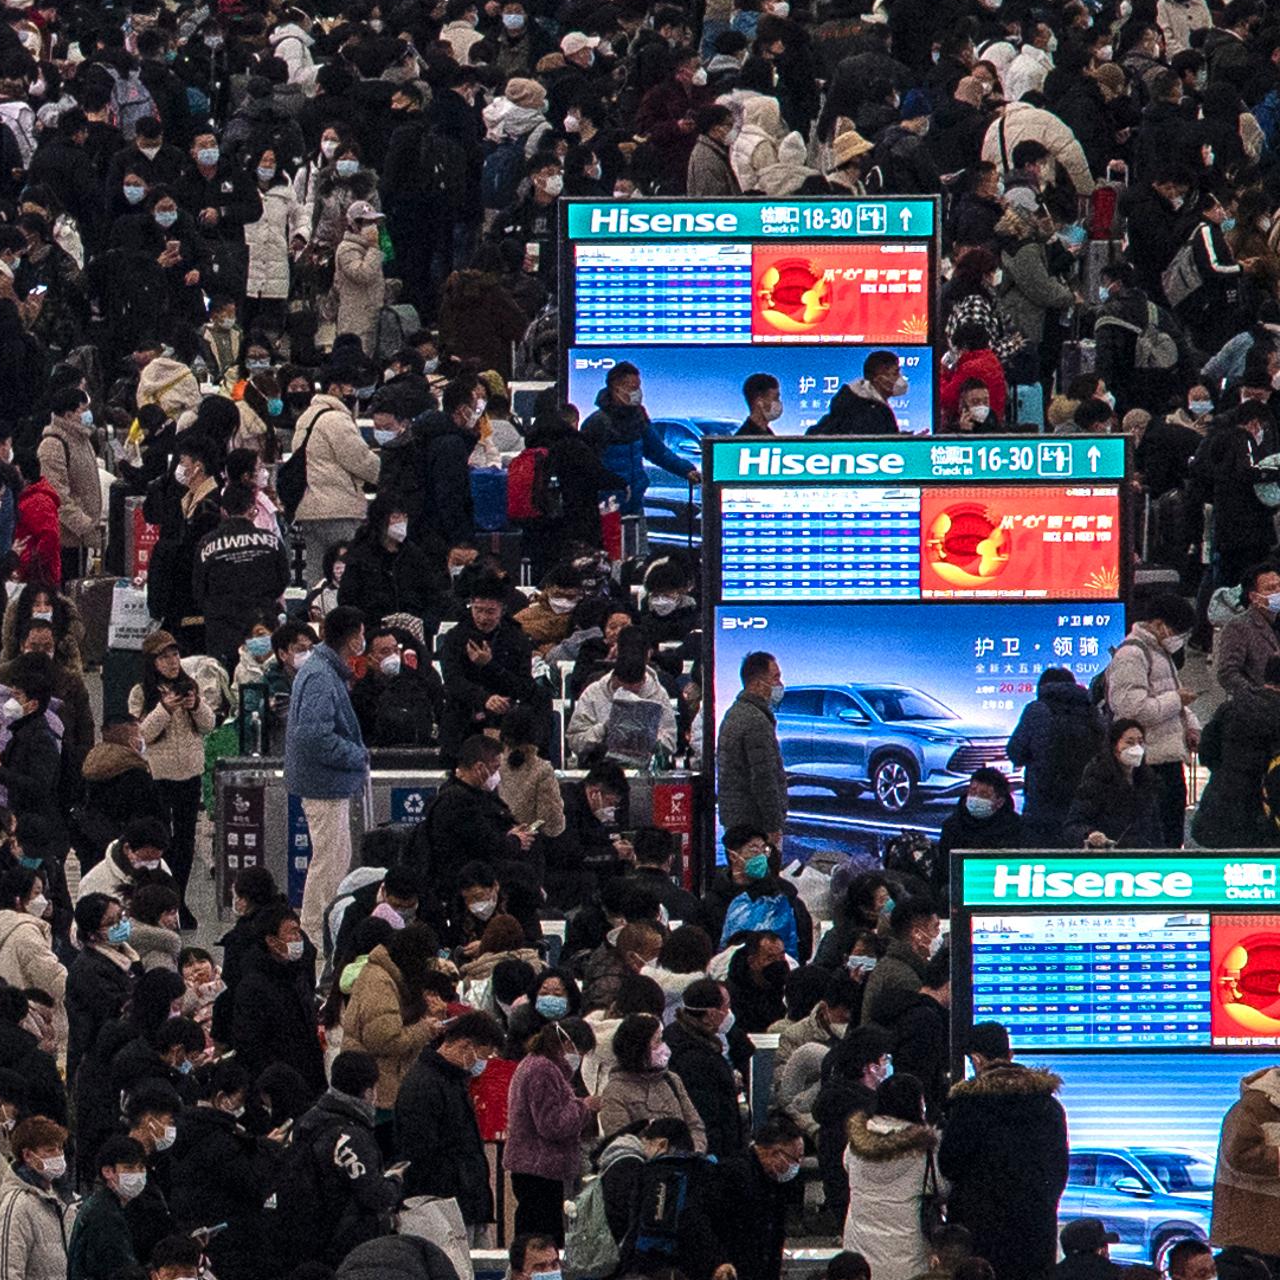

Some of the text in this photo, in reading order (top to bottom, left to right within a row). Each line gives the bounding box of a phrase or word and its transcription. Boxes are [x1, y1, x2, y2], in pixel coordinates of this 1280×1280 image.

[590, 208, 853, 233] Hisense 18-30
[906, 357, 920, 367] 07
[739, 447, 1033, 475] Hisense 16-30
[722, 617, 768, 629] BYD
[1095, 615, 1111, 626] 07
[1076, 663, 1100, 673] SUV
[993, 864, 1193, 898] Hisense
